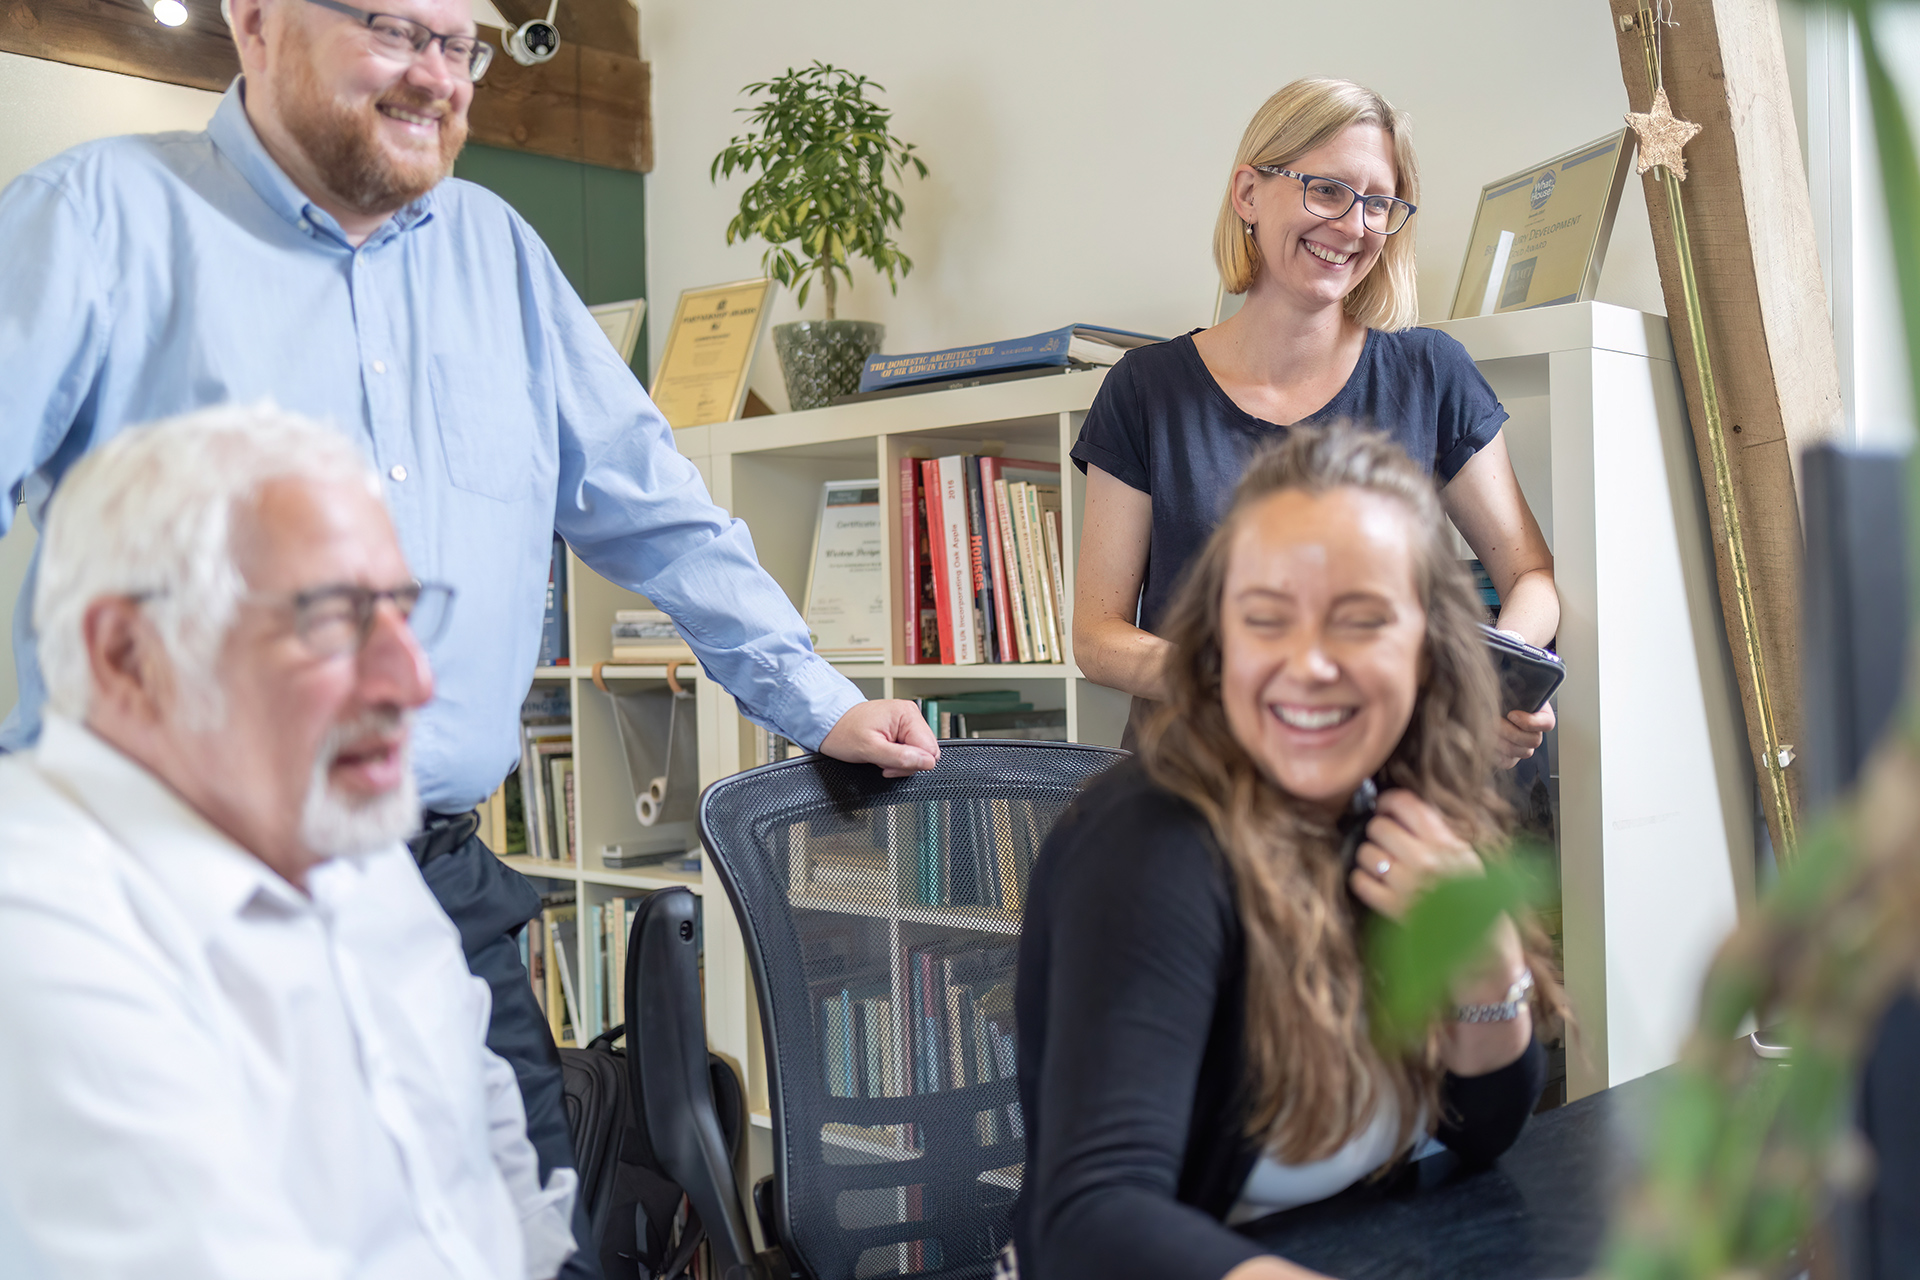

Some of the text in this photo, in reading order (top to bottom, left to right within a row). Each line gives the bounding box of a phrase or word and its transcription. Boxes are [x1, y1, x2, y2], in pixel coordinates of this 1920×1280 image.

[1529, 214, 1582, 241] DEVELOPMENT
[881, 357, 977, 378] OF SIR EDWIN LUTYENS
[887, 356, 929, 371] DOMESTIC
[930, 346, 996, 363] ARCHITECTURE
[836, 520, 877, 529] Certificate
[952, 523, 960, 548] Apple
[953, 550, 961, 568] Oak
[971, 535, 985, 591] Houses
[954, 570, 965, 628] Incorporating
